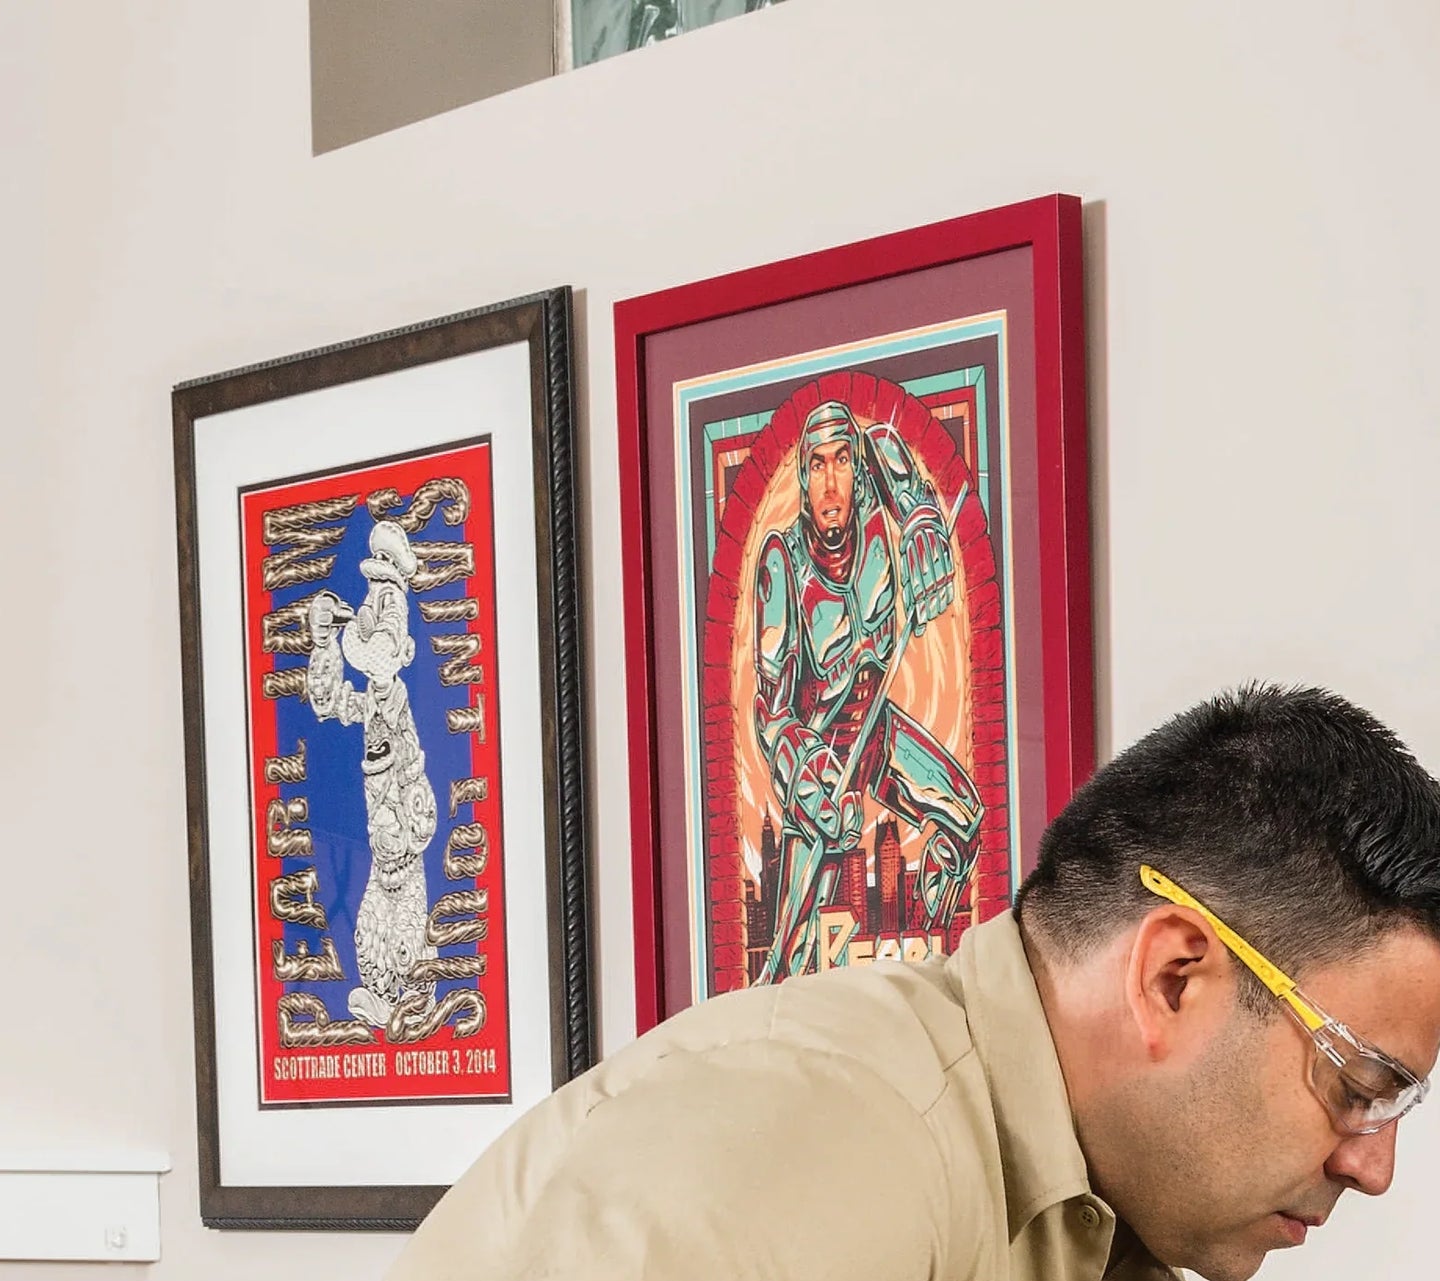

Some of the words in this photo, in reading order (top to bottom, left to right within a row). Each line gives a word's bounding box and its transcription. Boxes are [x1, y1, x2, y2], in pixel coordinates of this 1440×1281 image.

[367, 478, 486, 744] SAINT
[265, 738, 379, 1048] PEARL
[385, 777, 489, 1045] LOUIS
[274, 1055, 341, 1081] SCOTTRADE
[343, 1053, 386, 1078] CENTER
[395, 1050, 449, 1076] OCTOBER
[466, 1049, 497, 1074] 2014
